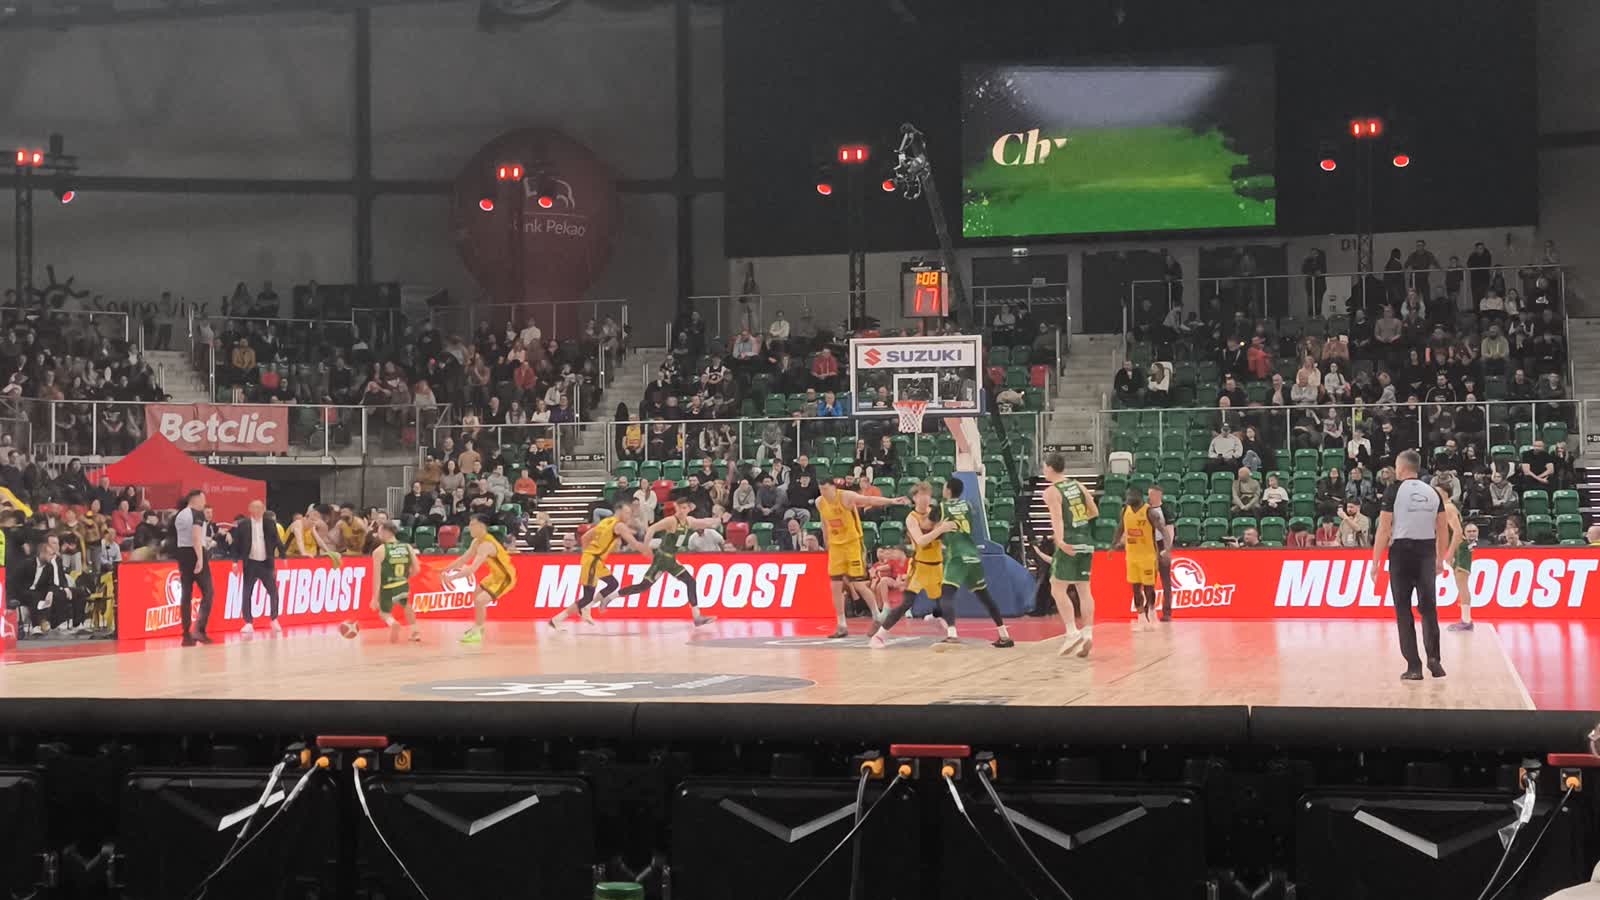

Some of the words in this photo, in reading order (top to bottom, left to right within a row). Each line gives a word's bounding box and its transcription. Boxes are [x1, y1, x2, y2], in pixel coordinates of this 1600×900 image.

[546, 219, 585, 236] Pekao
[916, 271, 939, 286] 1:08
[914, 288, 939, 312] 17
[886, 349, 962, 363] SUZUKI
[160, 412, 277, 444] Betclic
[394, 563, 405, 577] 0
[415, 591, 497, 610] MULTIBO
